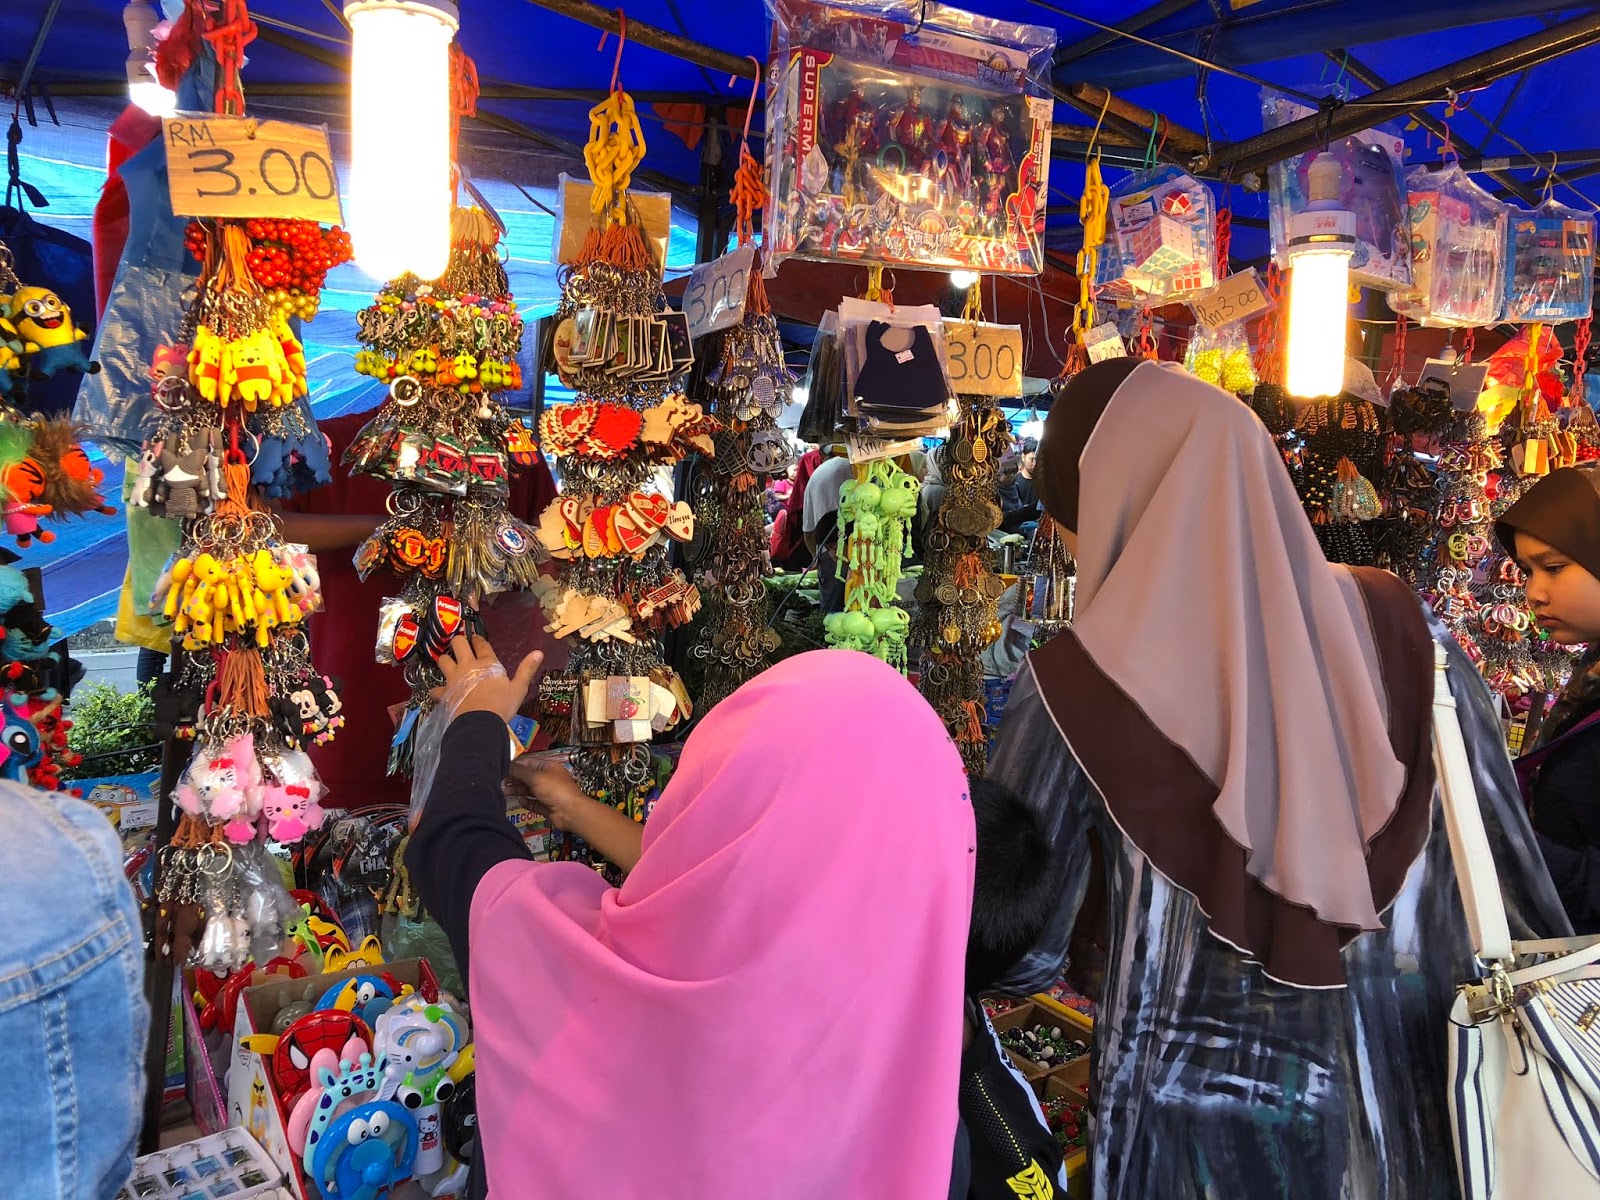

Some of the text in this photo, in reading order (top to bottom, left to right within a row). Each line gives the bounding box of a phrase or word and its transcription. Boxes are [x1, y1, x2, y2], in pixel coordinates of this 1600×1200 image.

[801, 54, 817, 158] SUPERM
[169, 121, 216, 147] RM
[188, 148, 335, 200] 3.00
[949, 341, 1015, 380] 3.00
[438, 600, 460, 612] Arsenal
